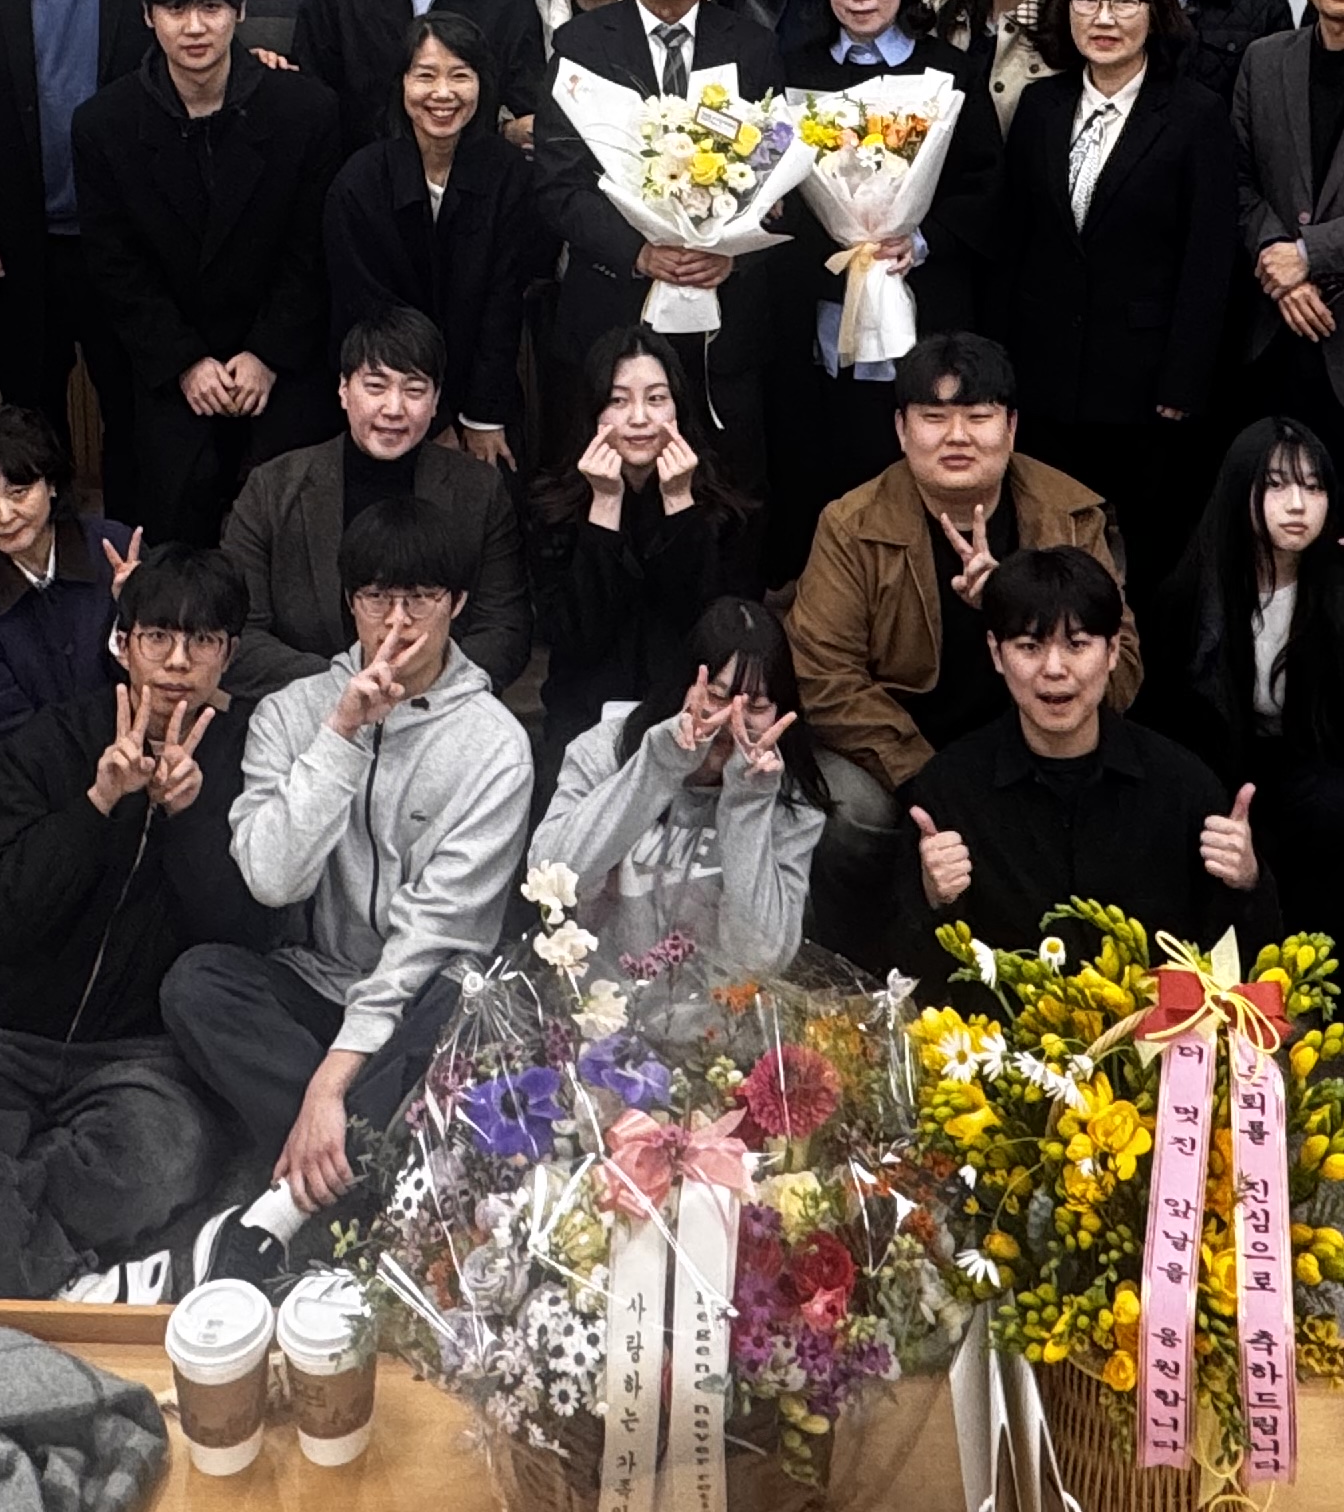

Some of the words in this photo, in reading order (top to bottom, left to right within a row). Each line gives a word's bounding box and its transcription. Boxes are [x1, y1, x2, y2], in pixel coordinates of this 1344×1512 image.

[1176, 1045, 1203, 1064] 더
[1168, 1105, 1199, 1156] 멋진
[1156, 1197, 1196, 1284] 앞날을
[1241, 1178, 1277, 1293] 진심으로
[620, 1292, 647, 1433] 사랑하는
[1150, 1326, 1186, 1452] 응원합니다
[1246, 1328, 1285, 1472] 축하드립니다
